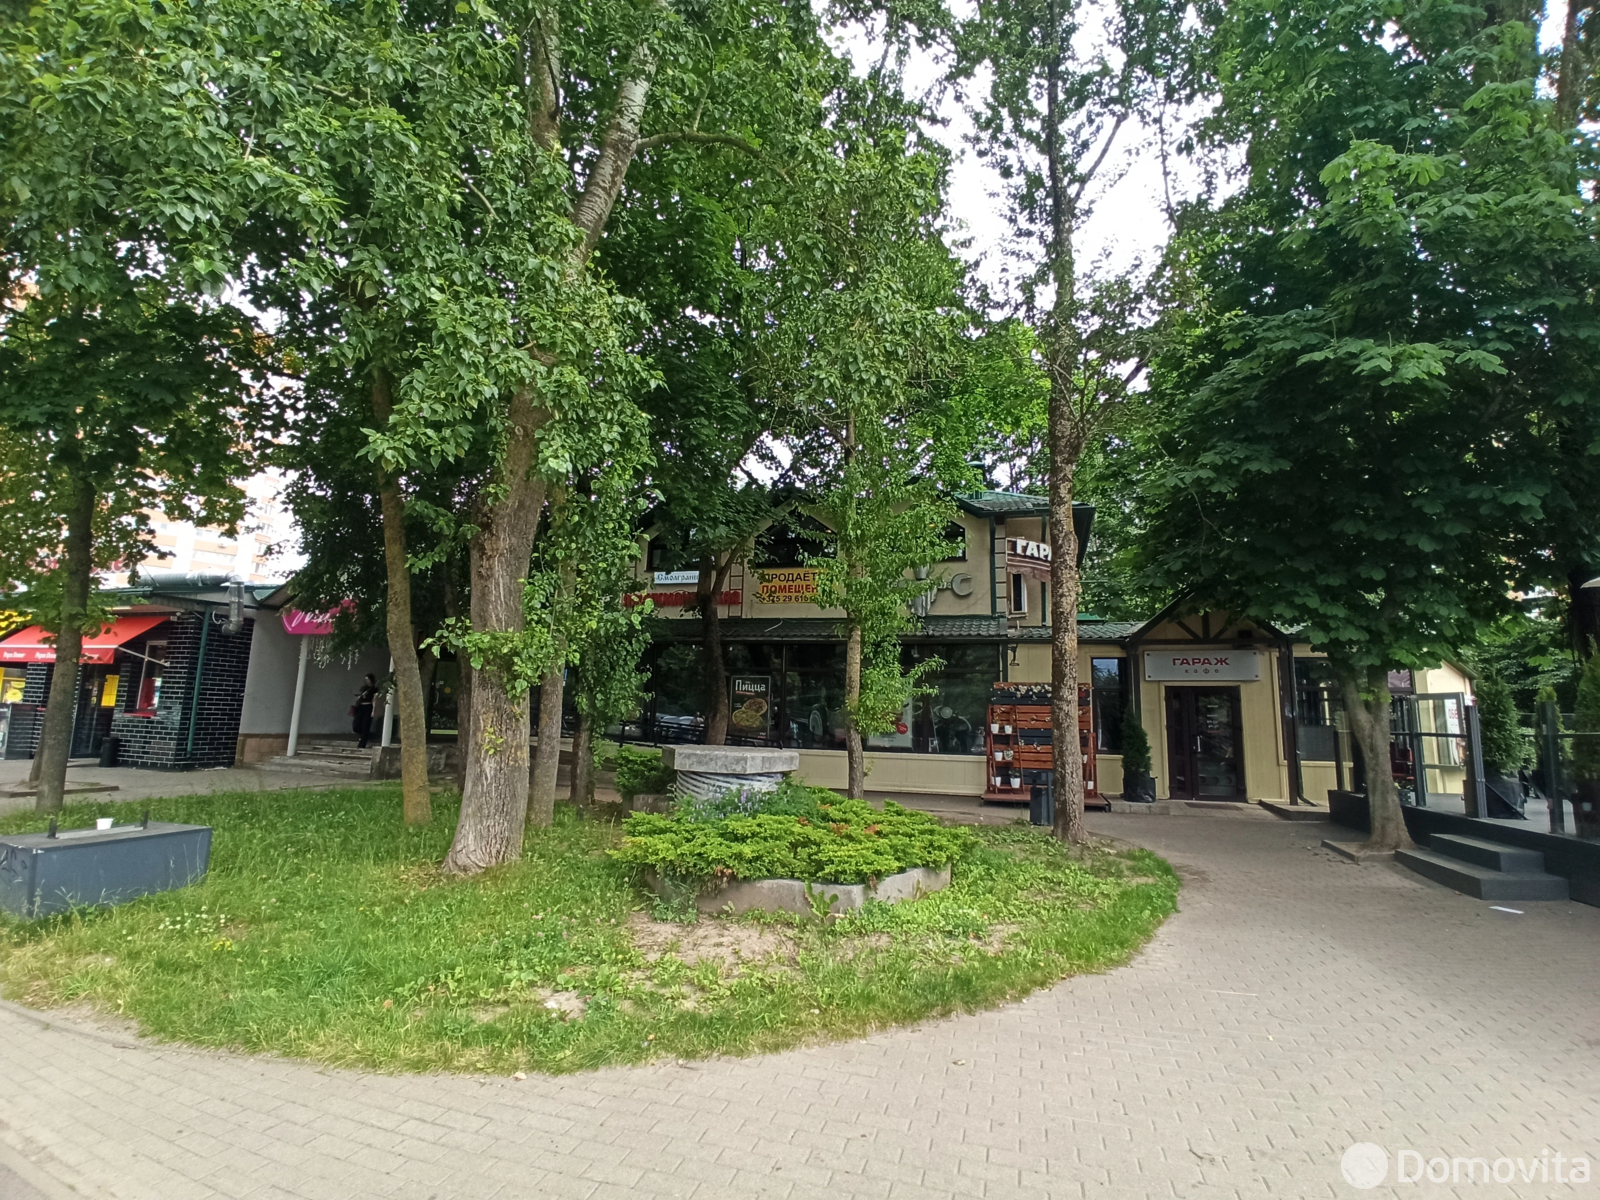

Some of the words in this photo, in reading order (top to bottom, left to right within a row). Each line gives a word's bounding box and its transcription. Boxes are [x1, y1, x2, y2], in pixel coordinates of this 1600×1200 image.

[1016, 539, 1051, 561] ГАР
[764, 571, 826, 585] ПРОДАЁТ
[761, 584, 820, 594] ПОМЕЩЕН
[783, 595, 792, 603] 29
[1172, 657, 1230, 666] ГАРАЖ
[735, 679, 766, 692] Пицца
